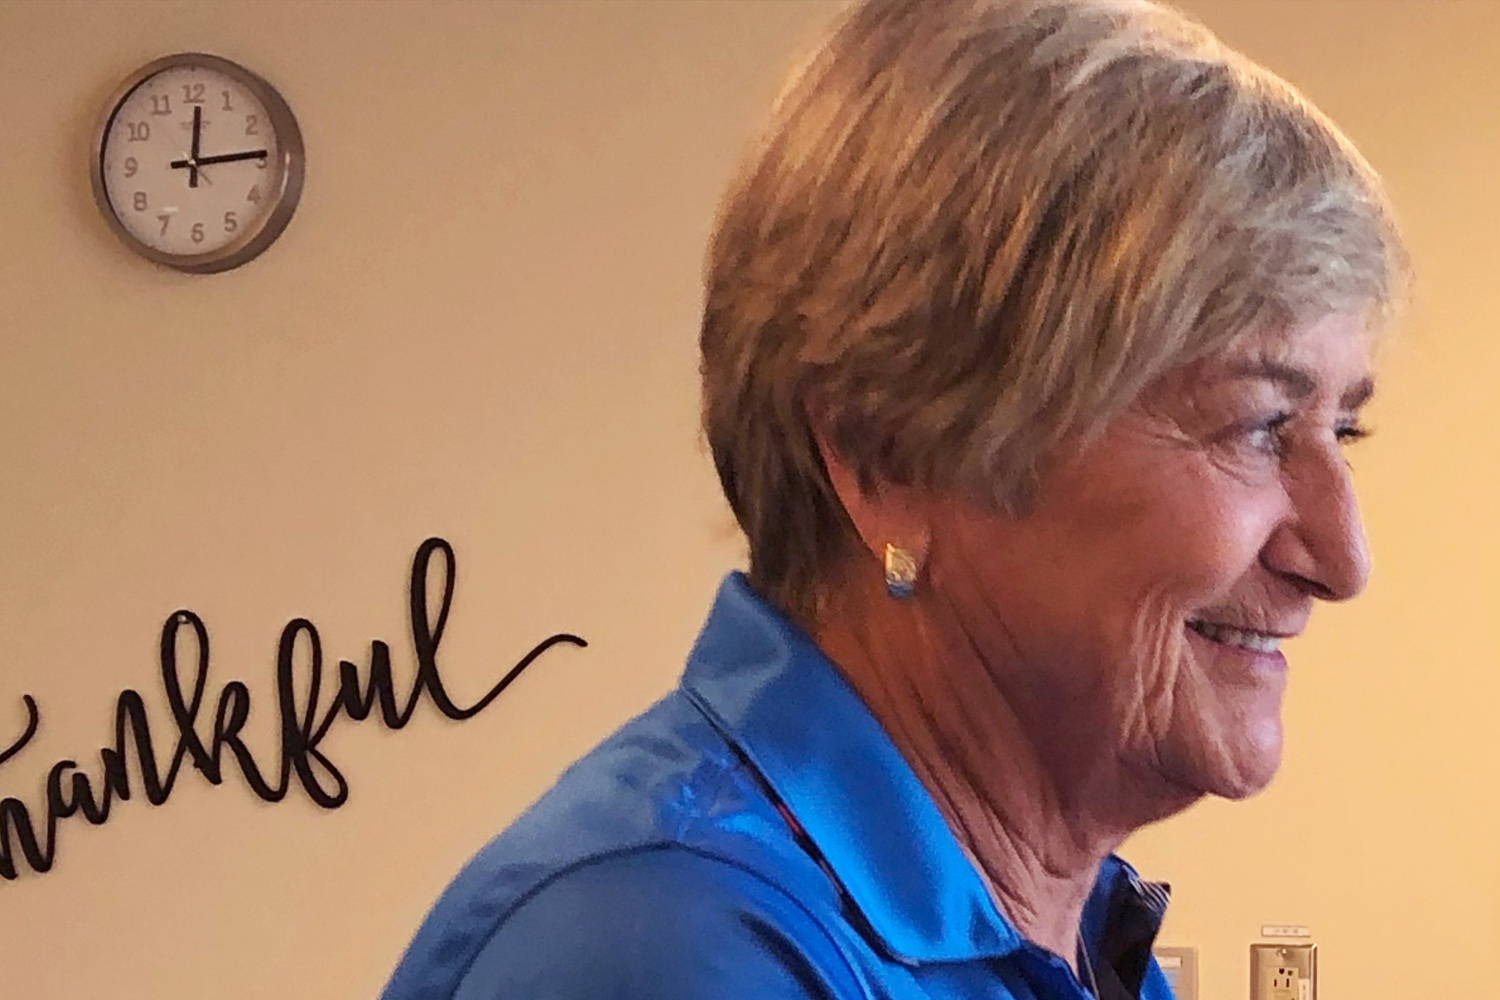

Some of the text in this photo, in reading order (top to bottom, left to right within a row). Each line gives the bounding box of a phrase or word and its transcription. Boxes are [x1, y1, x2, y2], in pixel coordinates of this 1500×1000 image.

[182, 83, 205, 104] 12
[221, 90, 233, 111] 1
[151, 95, 172, 116] 11
[127, 121, 150, 142] 10
[245, 115, 258, 135] 2
[124, 157, 138, 178] 9
[133, 191, 147, 212] 8
[247, 184, 261, 204] 4
[157, 214, 171, 236] 7
[224, 211, 237, 232] 5
[191, 223, 205, 243] 6
